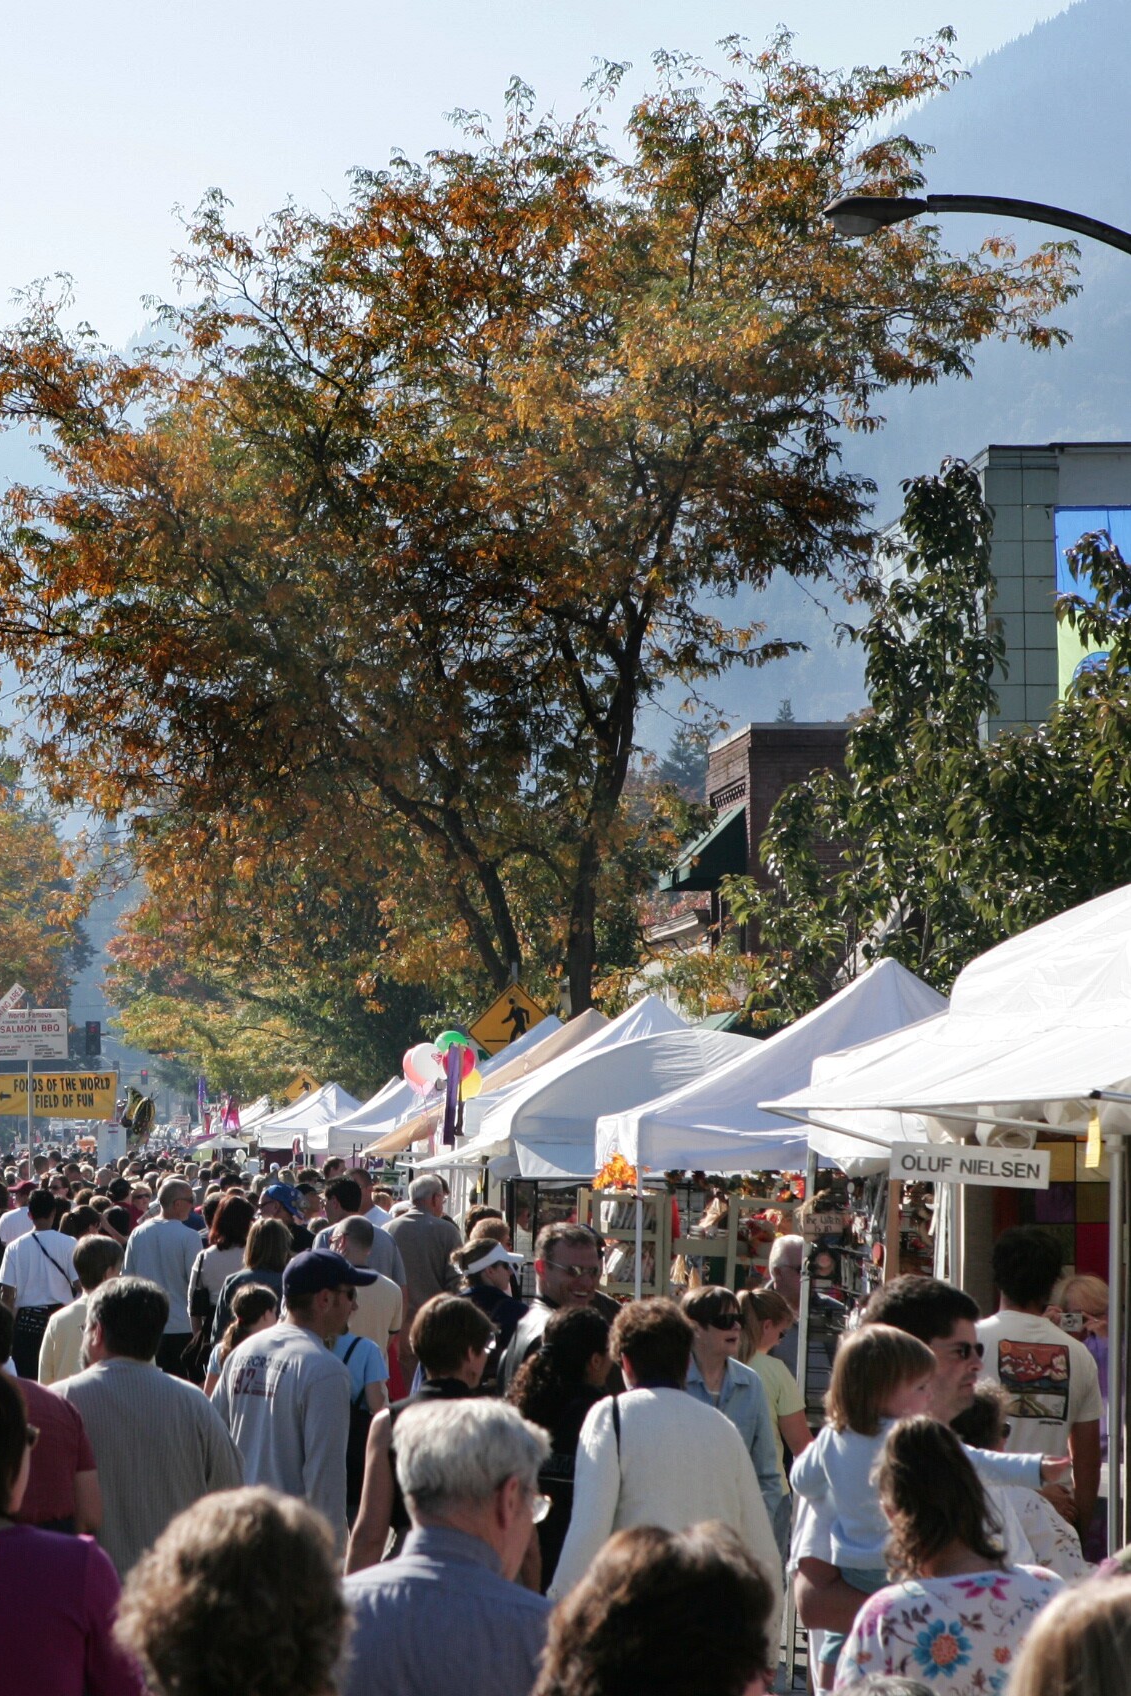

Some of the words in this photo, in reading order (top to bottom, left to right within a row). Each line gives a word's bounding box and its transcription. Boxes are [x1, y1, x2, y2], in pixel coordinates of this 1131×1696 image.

[9, 986, 24, 1002] AREA
[0, 1025, 37, 1033] SALMON
[41, 1024, 60, 1032] BBQ
[46, 1078, 58, 1092] OF
[60, 1077, 77, 1091] THE
[79, 1076, 110, 1091] WORLD
[35, 1094, 59, 1108] FIELD
[62, 1093, 74, 1108] OF
[76, 1093, 94, 1107] FUN
[900, 1154, 952, 1174] OLUF
[959, 1158, 1040, 1179] NIELSEN
